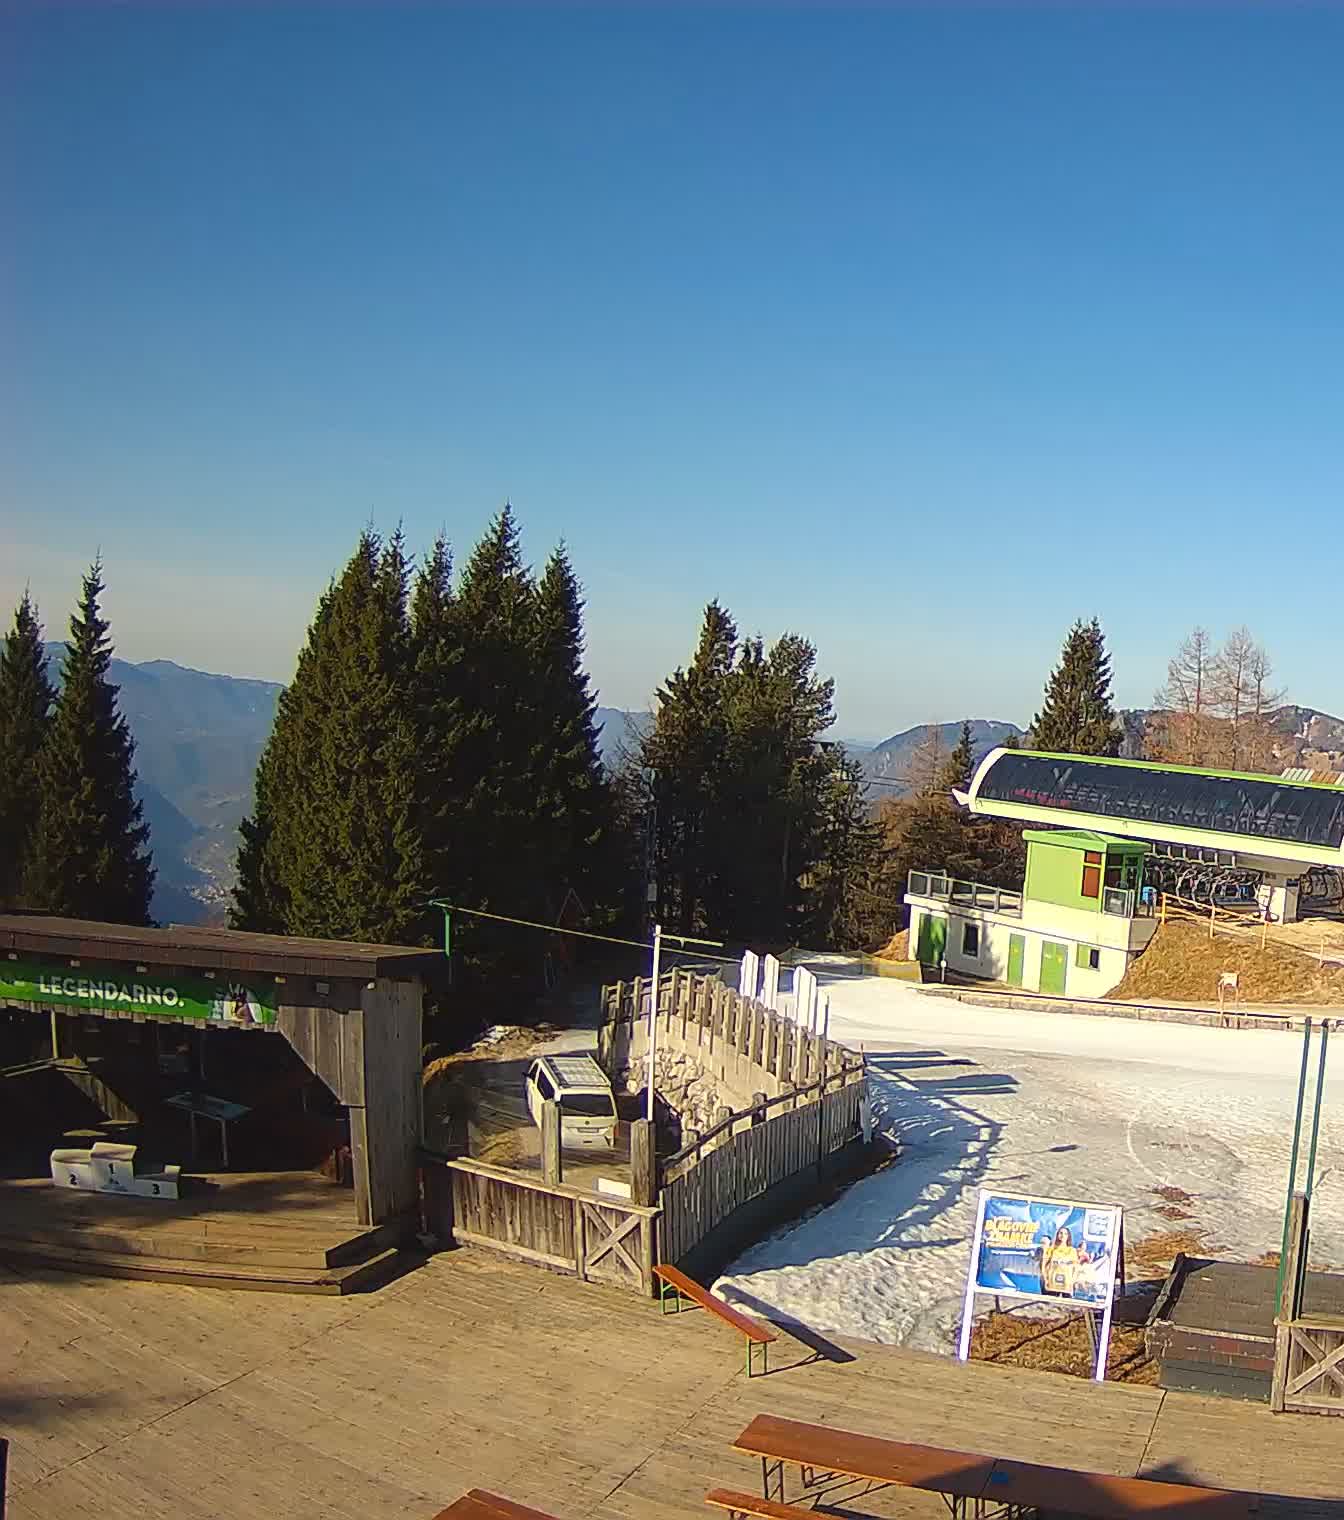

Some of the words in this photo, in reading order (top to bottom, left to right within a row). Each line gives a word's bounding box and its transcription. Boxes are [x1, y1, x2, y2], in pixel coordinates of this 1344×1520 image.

[108, 1163, 115, 1174] 1
[69, 1174, 78, 1185] 2
[152, 1184, 161, 1195] 3
